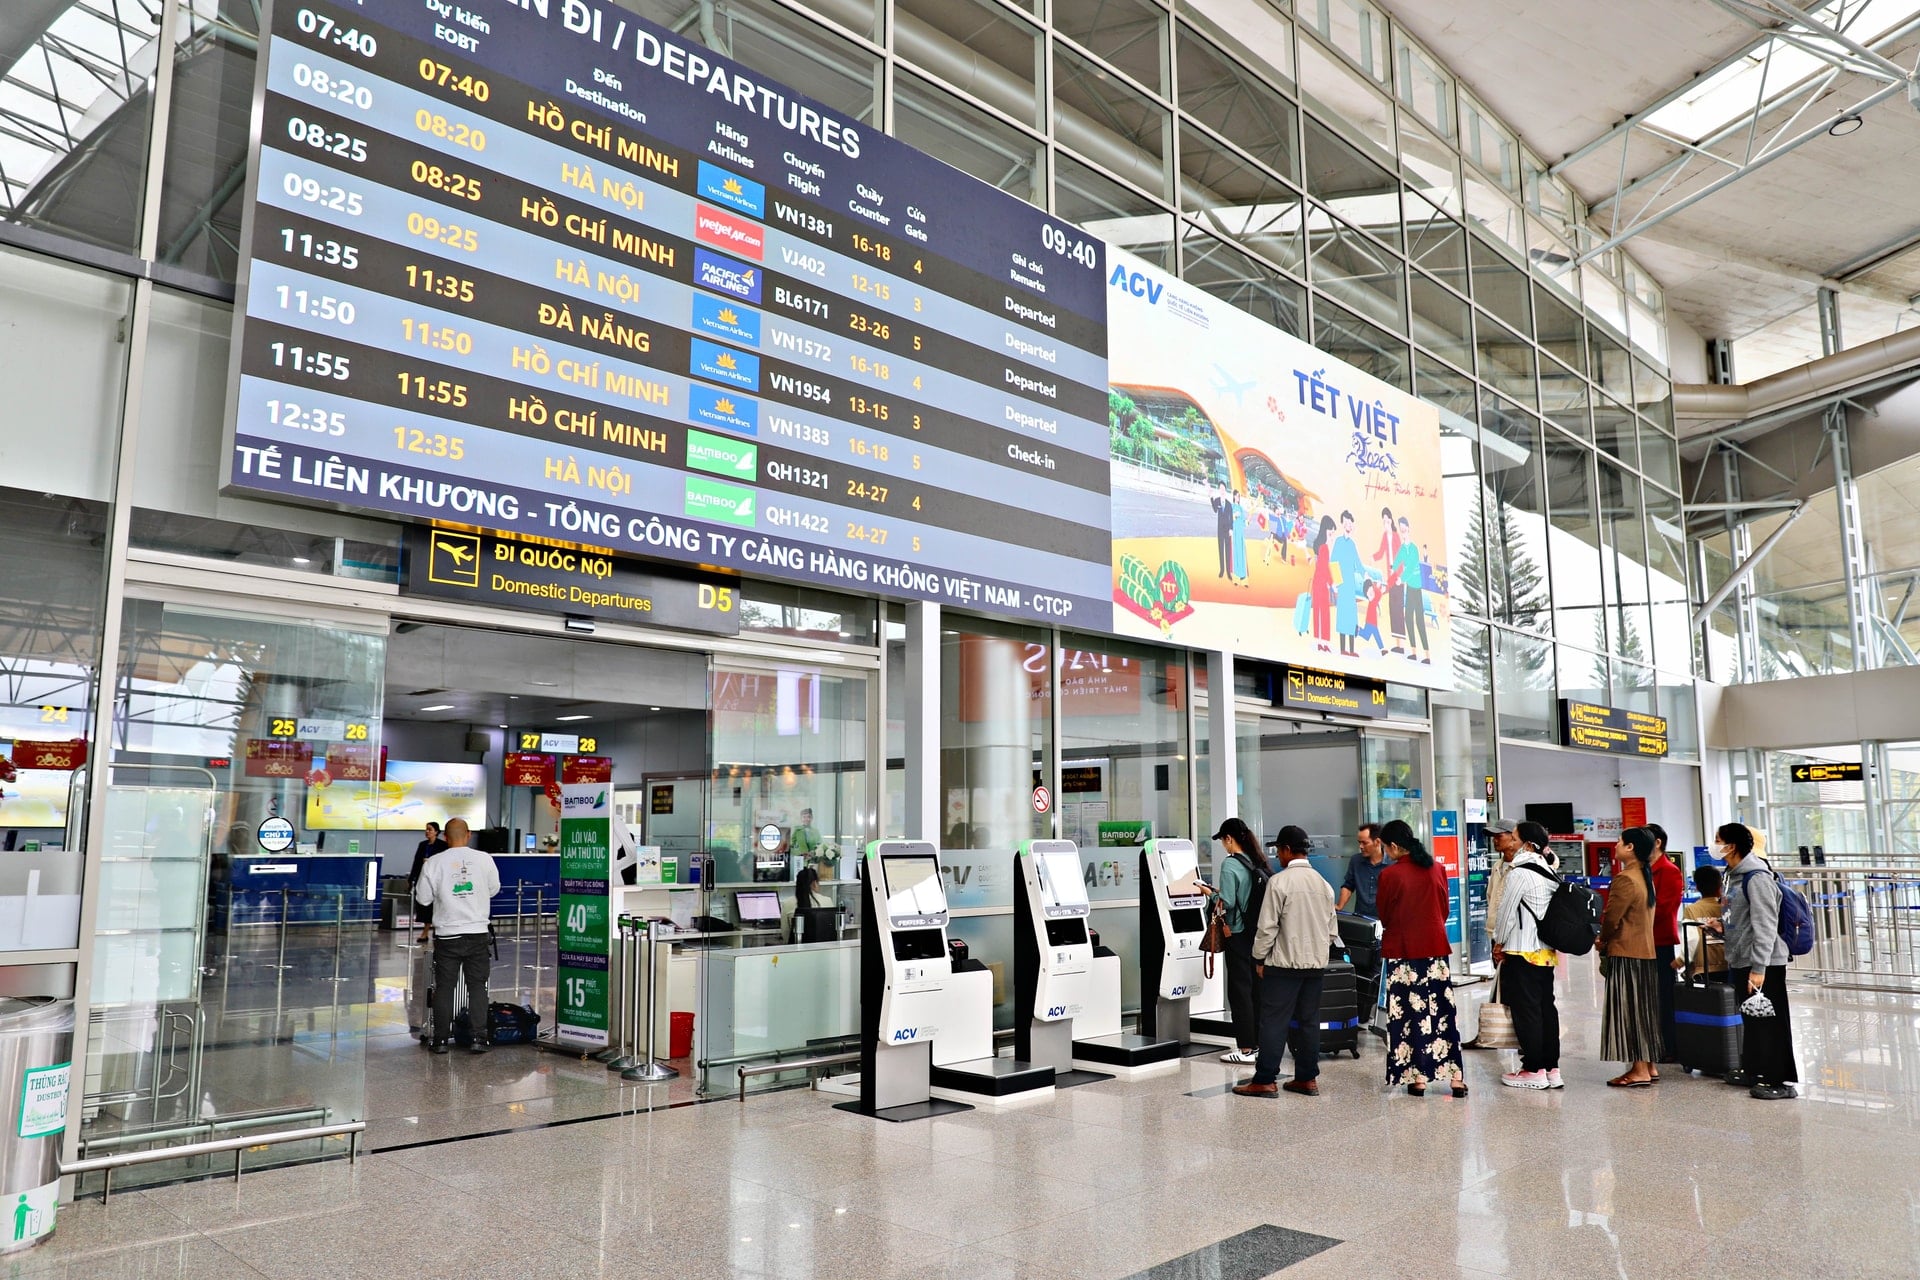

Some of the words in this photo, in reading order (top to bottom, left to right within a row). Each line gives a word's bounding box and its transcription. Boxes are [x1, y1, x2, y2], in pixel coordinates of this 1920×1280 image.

[426, 0, 450, 18] Dự
[455, 6, 491, 35] kiến
[298, 8, 377, 58] 07:40
[435, 23, 480, 53] EOBT
[293, 63, 373, 110] 08:20
[419, 58, 490, 103] 07:40
[562, 0, 601, 43] ĐI
[636, 29, 861, 160] DEPARTURES
[593, 67, 622, 92] Đến
[565, 78, 647, 124] Destination
[287, 117, 368, 163] 08:25
[415, 108, 487, 152] 08:20
[527, 100, 566, 132] HỒ
[571, 118, 611, 151] CHÍ
[617, 140, 679, 178] MINH
[715, 120, 749, 149] Hãng
[707, 140, 755, 170] Airlines
[783, 151, 826, 179] Chuyến
[283, 172, 363, 216] 09:25
[411, 160, 482, 202] 08:25
[561, 160, 596, 194] HÀ
[602, 176, 645, 210] NỘI
[788, 173, 821, 198] Flight
[856, 183, 884, 207] Quầy
[708, 185, 734, 202] Vietnam
[734, 194, 757, 211] Airlines
[775, 201, 833, 238] VN1381
[848, 200, 891, 227] Counter
[906, 205, 927, 224] Cửa
[407, 212, 479, 252] 09:25
[521, 197, 559, 228] HỒ
[566, 214, 607, 246] CHÍ
[612, 235, 675, 268] MINH
[905, 223, 928, 243] Gate
[1041, 223, 1096, 270] 09:40
[281, 227, 359, 270] 11:35
[782, 246, 825, 277] VJ402
[852, 233, 891, 262] 16-18
[702, 262, 741, 284] PACIFIC
[913, 259, 922, 274] 4
[1011, 252, 1027, 268] Ghi
[1028, 260, 1044, 275] chú
[406, 265, 475, 303] 11:35
[556, 257, 590, 289] HÀ
[599, 271, 640, 303] NỘI
[851, 273, 890, 301] 12-15
[1010, 268, 1046, 293] Remarks
[1109, 264, 1164, 305] ACV
[276, 285, 355, 325] 11:50
[775, 287, 829, 320] BL6171
[913, 298, 922, 313] 3
[1004, 295, 1056, 328] Departed
[402, 318, 472, 355] 11:50
[538, 302, 576, 329] ĐÀ
[581, 313, 651, 353] NẴNG
[702, 317, 730, 332] Vietnam
[730, 325, 753, 340] Airlines
[850, 313, 890, 340] 23-26
[771, 328, 832, 362] VN1572
[913, 336, 922, 351] 5
[1005, 332, 1056, 363] Departed
[271, 342, 350, 381] 11:55
[512, 345, 550, 374] HỒ
[557, 359, 599, 389] CHÍ
[605, 370, 670, 406] MINH
[701, 363, 728, 377] Vietnam
[728, 370, 752, 384] Airlines
[850, 354, 889, 380] 16-18
[398, 372, 468, 407] 11:55
[769, 372, 831, 404] VN1954
[912, 375, 922, 391] 4
[1005, 369, 1057, 399] Departed
[1293, 368, 1340, 419] TẾT
[266, 400, 346, 437] 12:35
[849, 397, 888, 421] 13-15
[912, 415, 921, 430] 3
[1005, 405, 1057, 435] Departed
[1348, 394, 1400, 449] VIỆT
[508, 396, 547, 426] HỒ
[554, 409, 597, 438] CHÍ
[603, 422, 667, 454] MINH
[768, 415, 830, 447] VN1383
[394, 426, 464, 461] 12:35
[689, 444, 738, 463] BAMBOO
[848, 437, 888, 462] 16-18
[1007, 444, 1055, 470] Check-in
[545, 456, 582, 485] HÀ
[588, 467, 631, 498] NỘI
[767, 461, 829, 491] QH1321
[912, 455, 921, 470] 5
[688, 491, 737, 509] BAMBOO
[847, 480, 888, 503] 24-27
[912, 496, 921, 511] 4
[236, 445, 282, 480] TẾ
[293, 455, 369, 496] LIÊN
[379, 473, 519, 520] KHƯƠNG
[545, 499, 622, 538] TỔNG
[627, 515, 701, 554] CÔNG
[707, 532, 736, 559] TY
[741, 535, 805, 570] CẢNG
[810, 547, 868, 583] HÀNG
[872, 563, 940, 595] KHÔNG
[943, 576, 982, 605] VIỆT
[984, 585, 1021, 610] NAM
[1032, 594, 1073, 618] CTCP
[766, 506, 829, 535] QH1422
[846, 523, 888, 545] 24-27
[912, 537, 920, 551] 5
[494, 543, 515, 562] ĐI
[520, 548, 575, 573] QUỐC
[581, 557, 613, 580] NỘI
[492, 575, 566, 600] Domestic
[570, 588, 652, 612] Departures
[698, 583, 733, 612] D5
[1307, 675, 1314, 685] ĐI
[1315, 676, 1333, 689] QUỐC
[1334, 679, 1345, 692] NỘI
[1372, 689, 1385, 706] D4
[41, 705, 68, 723] 24
[1308, 693, 1332, 705] Domestic
[1332, 696, 1359, 708] Departures
[272, 719, 295, 736] 25
[300, 725, 320, 734] ACV
[346, 724, 367, 740] 26
[522, 734, 539, 749] 27
[580, 738, 596, 752] 28
[36, 753, 71, 767] 2026
[265, 763, 293, 775] 2026
[343, 766, 369, 778] 2026
[519, 772, 541, 784] 2026
[565, 796, 594, 805] BAMBOO
[583, 829, 597, 844] VÀO
[563, 845, 577, 859] LÀM
[567, 904, 587, 934] 40
[566, 977, 585, 1007] 15
[1172, 985, 1187, 996] ACV
[1048, 1006, 1066, 1017] ACV
[894, 1027, 917, 1040] ACV
[30, 1074, 57, 1091] THÙNG
